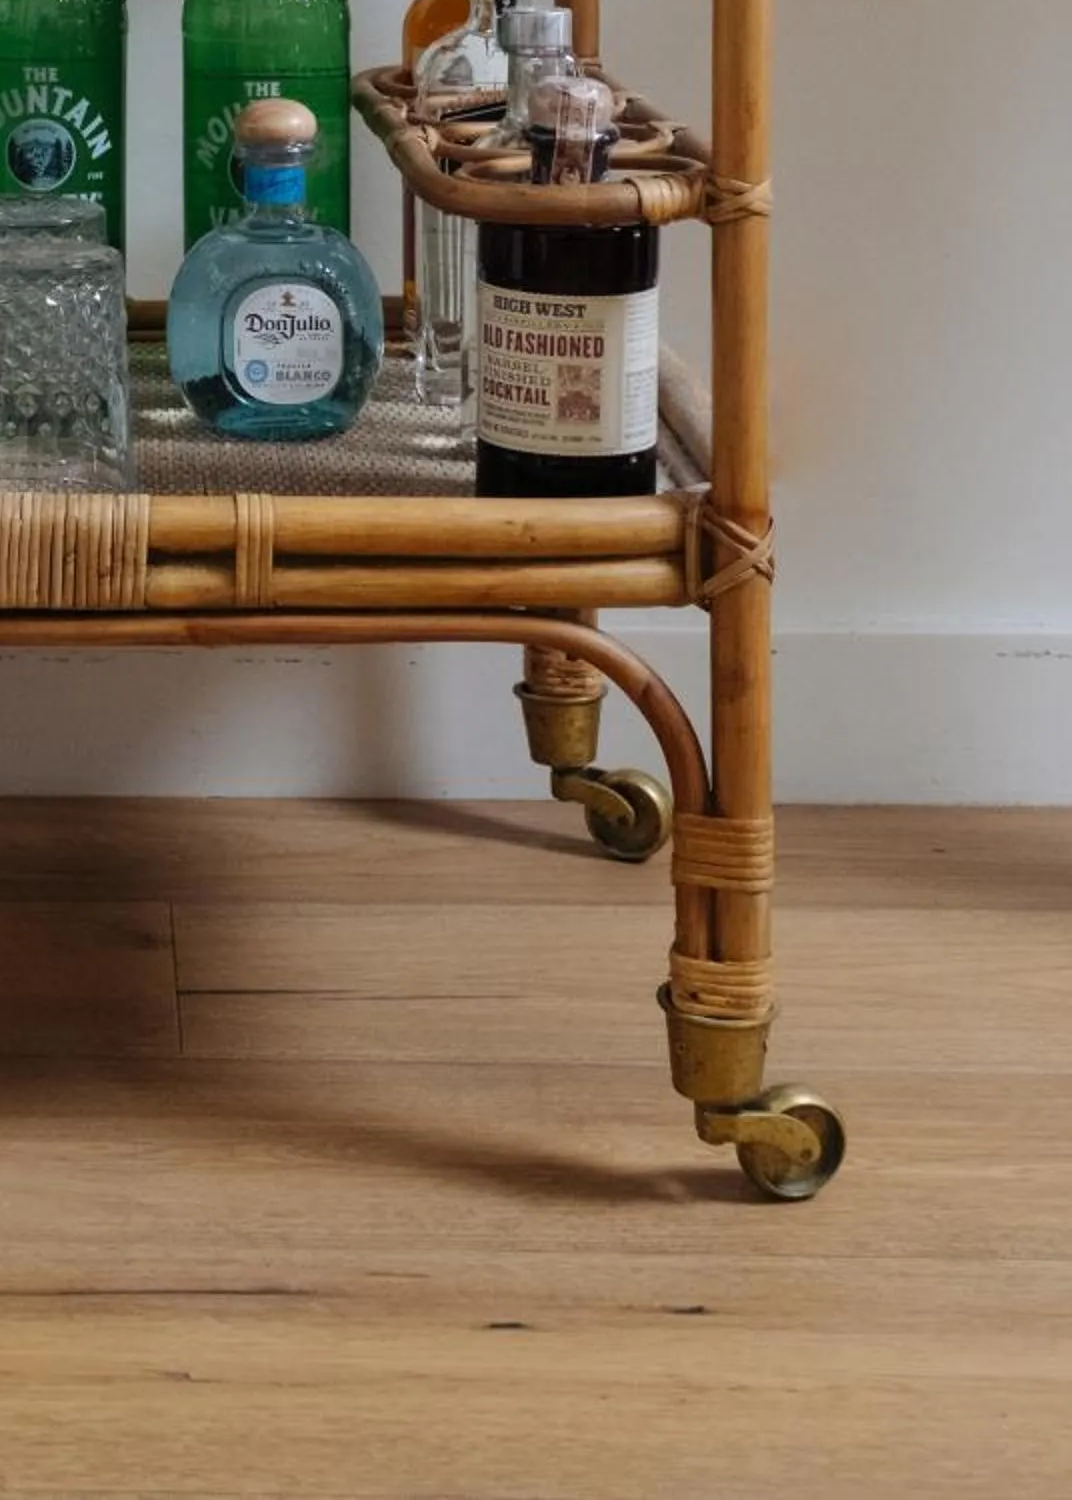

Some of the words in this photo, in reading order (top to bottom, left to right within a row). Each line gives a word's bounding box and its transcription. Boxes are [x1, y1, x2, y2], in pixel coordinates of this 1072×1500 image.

[21, 67, 60, 83] THE
[243, 80, 281, 97] THE
[493, 295, 531, 315] HIGH
[535, 302, 588, 318] WEST
[507, 329, 606, 359] FASHIONED
[275, 369, 332, 382] BLANCO
[482, 376, 551, 406] COCKTAIL
